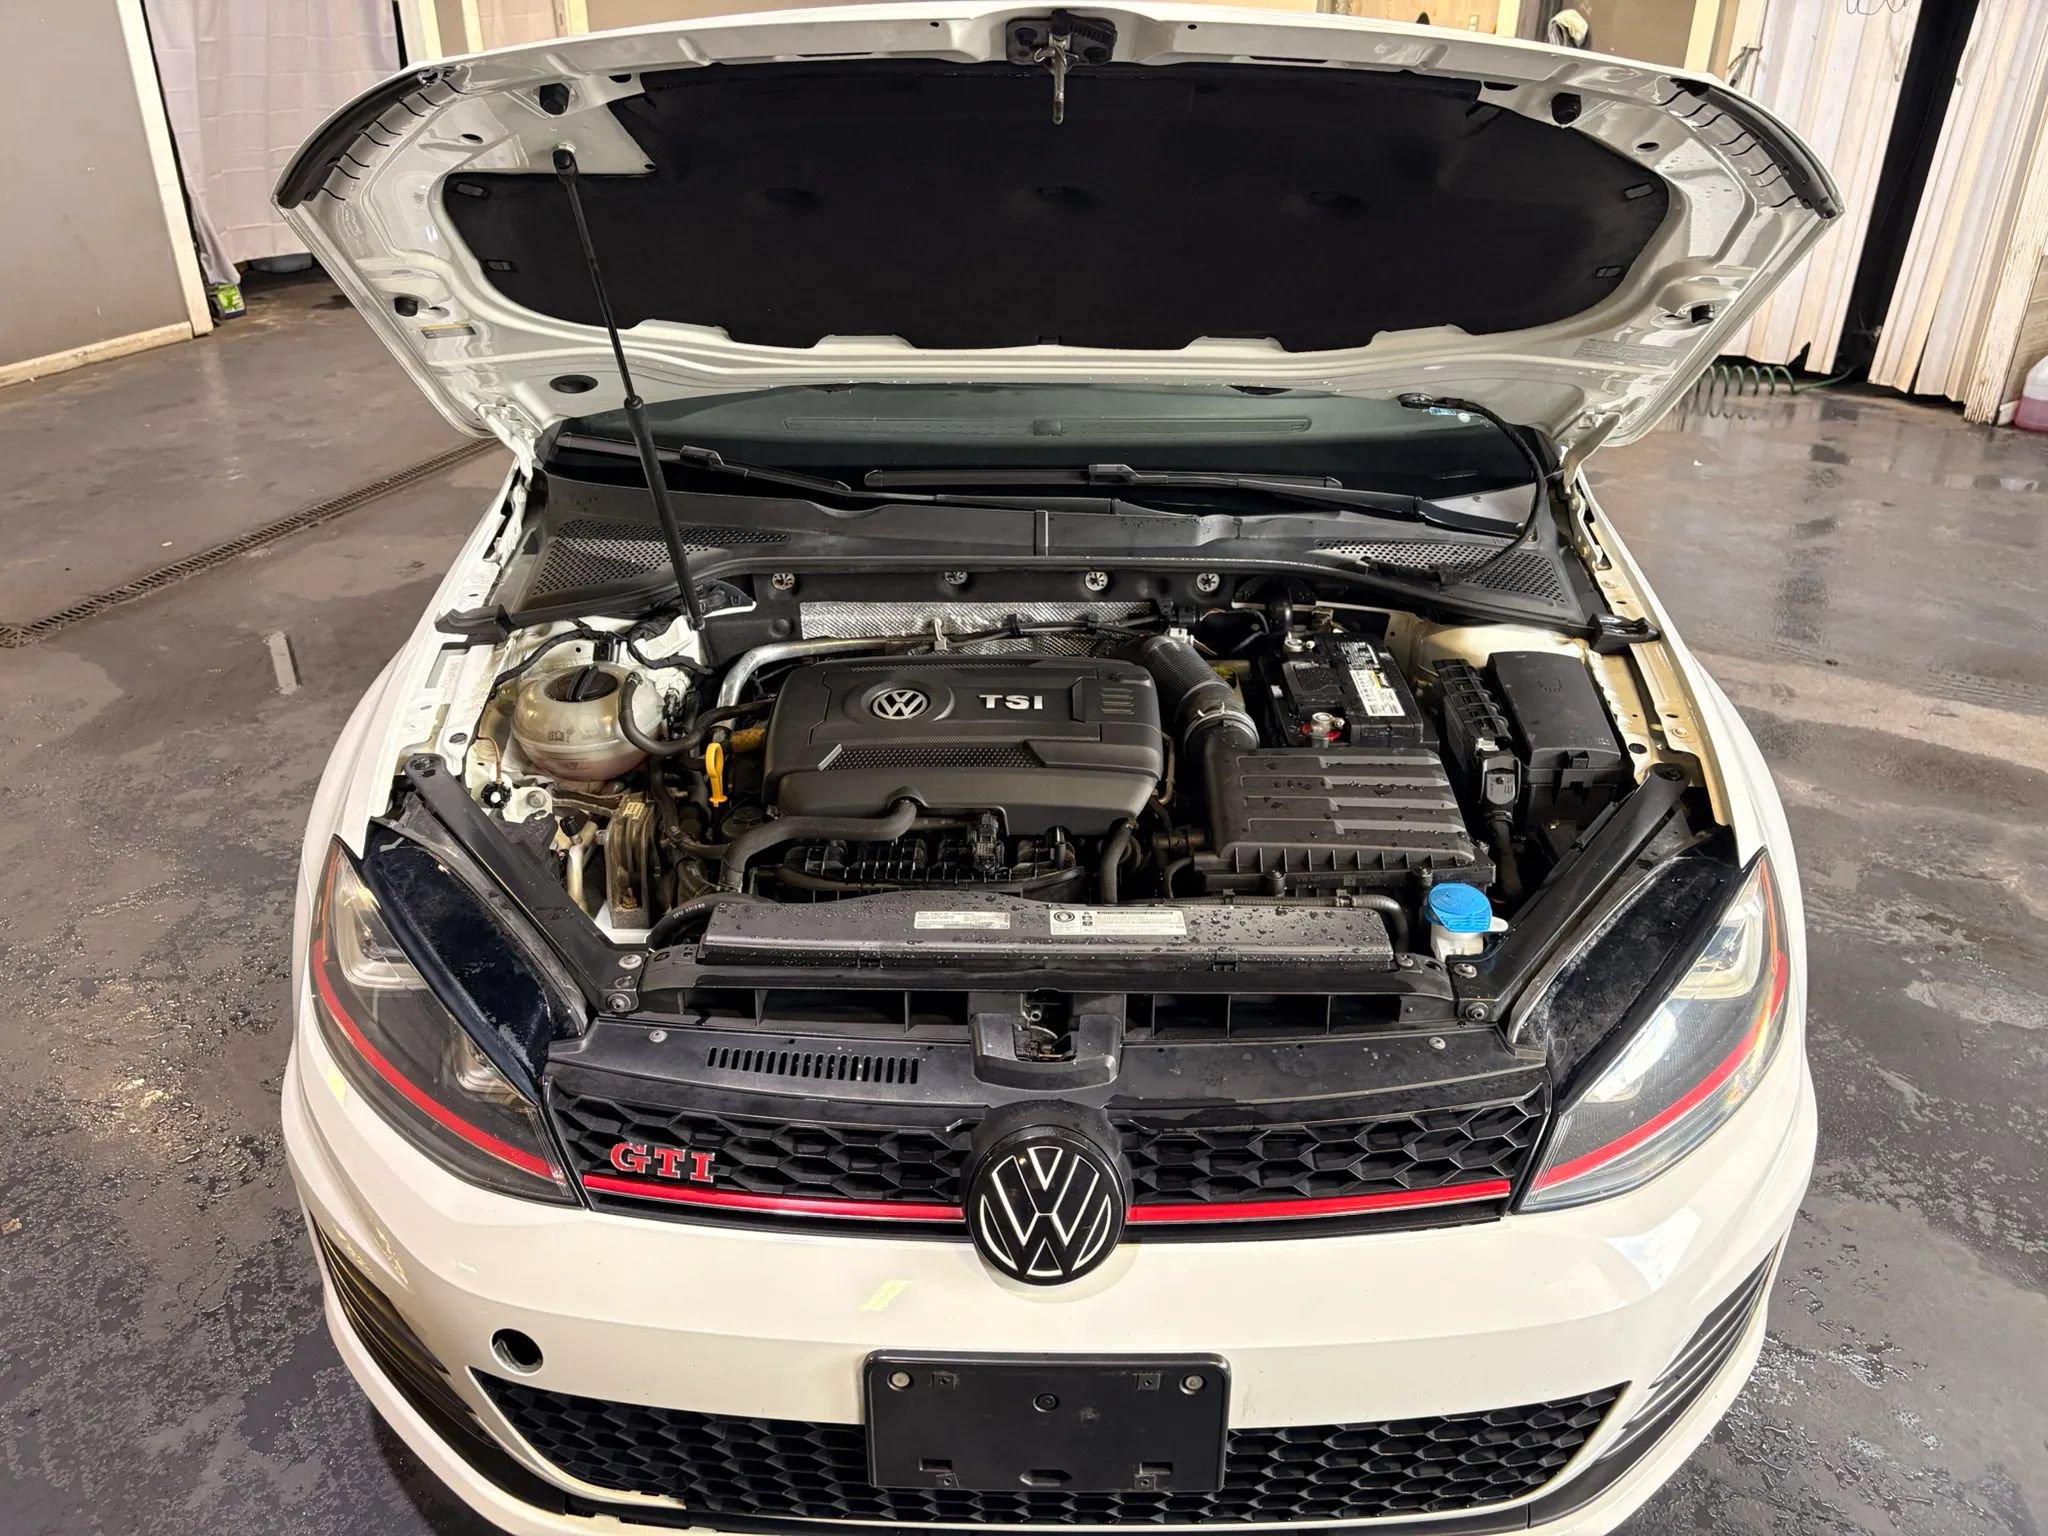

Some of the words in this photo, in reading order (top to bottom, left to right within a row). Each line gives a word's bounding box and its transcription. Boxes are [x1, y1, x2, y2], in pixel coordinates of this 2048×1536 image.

[872, 689, 928, 720] VW
[979, 694, 1044, 710] TSI
[610, 1142, 716, 1183] GTI
[980, 1145, 1112, 1277] VW
